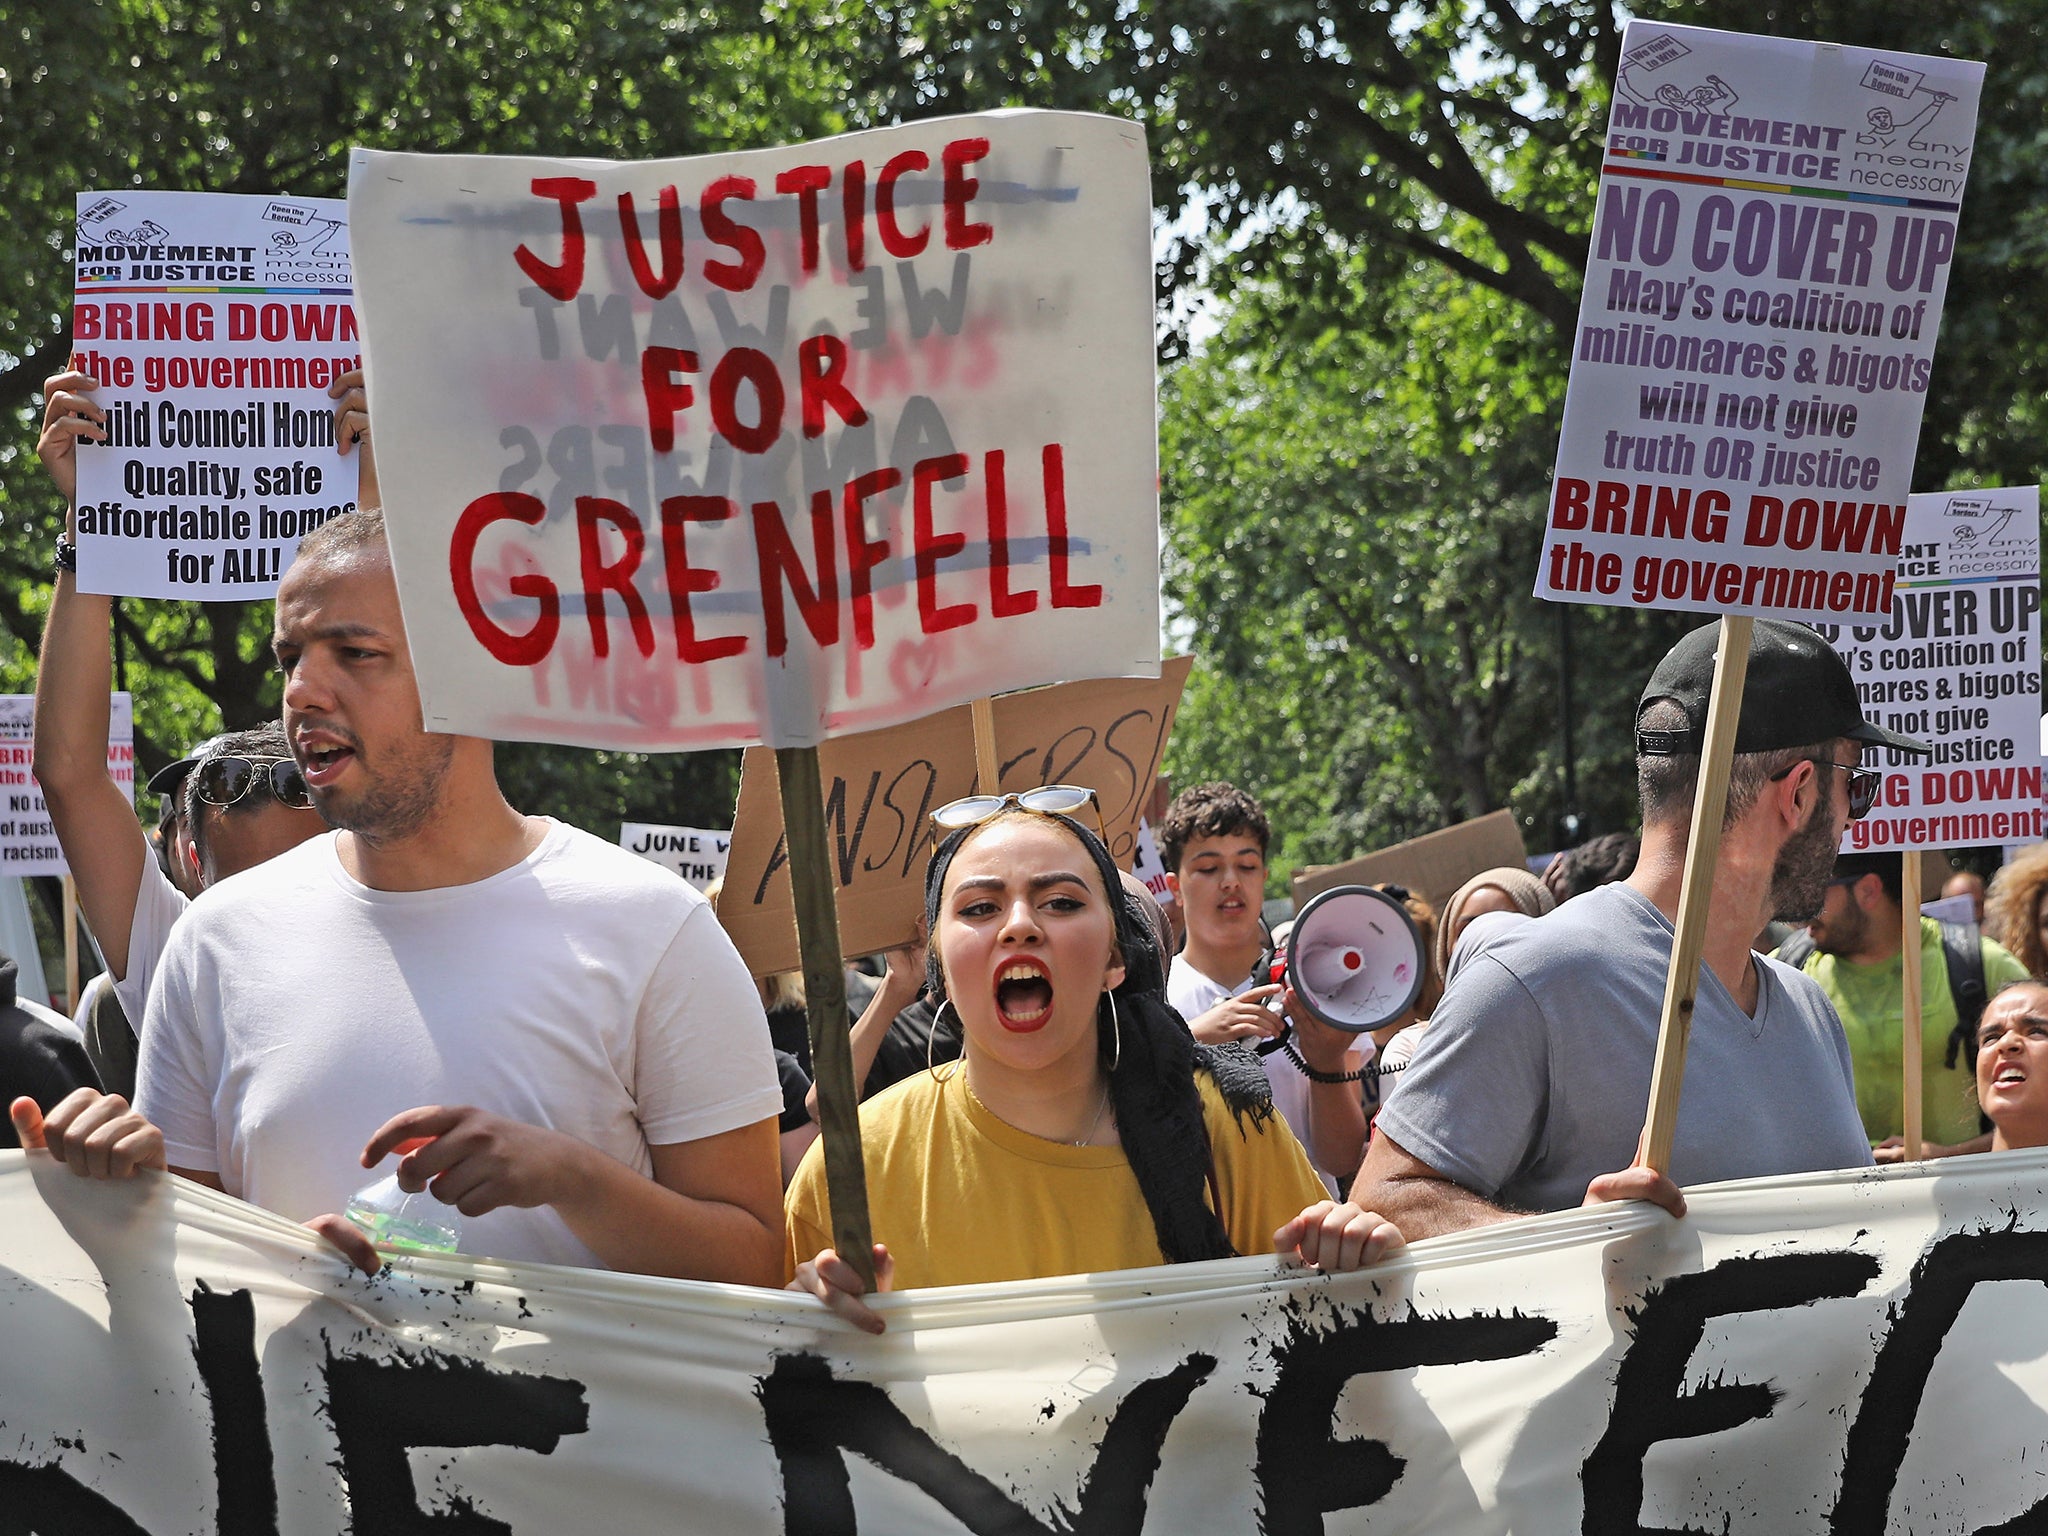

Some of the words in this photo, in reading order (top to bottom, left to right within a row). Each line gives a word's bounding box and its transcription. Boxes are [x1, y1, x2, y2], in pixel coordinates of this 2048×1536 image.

[1631, 50, 1649, 61] We
[1648, 37, 1674, 54] fight
[1645, 59, 1658, 69] to
[1656, 48, 1679, 66] WIN
[1871, 78, 1904, 97] Borders
[1873, 65, 1895, 79] Open
[1895, 72, 1909, 84] the
[1612, 104, 1846, 151] MOVEMENT
[1609, 134, 1670, 152] FOR
[1676, 140, 1841, 181] JUSTICE
[1856, 132, 1896, 149] by
[1908, 141, 1969, 158] any
[1854, 152, 1965, 173] means
[1850, 169, 1963, 198] necessary
[271, 213, 301, 225] Borders
[272, 205, 291, 215] Open
[292, 208, 305, 216] the
[514, 137, 994, 301] JUSTICE
[78, 246, 257, 262] MOVEMENT
[265, 248, 300, 258] by
[311, 251, 349, 259] an
[1597, 185, 1679, 267] NO
[1691, 194, 1878, 288] COVER
[1886, 216, 1956, 294] UP
[78, 266, 121, 277] FOR
[129, 265, 255, 281] JUSTICE
[266, 261, 352, 269] mean
[1607, 268, 1713, 321] May's
[1722, 288, 1886, 338] coalition
[1890, 300, 1926, 340] of
[74, 302, 214, 341] BRING
[228, 303, 360, 342] DOWN
[74, 351, 134, 388] the
[144, 354, 362, 392] governmen
[1579, 323, 1787, 381] milionares
[1793, 347, 1819, 383] &
[1825, 343, 1931, 393] bigots
[642, 335, 869, 454] FOR
[157, 400, 265, 448] Council
[273, 402, 335, 448] Hom
[1639, 382, 1709, 426] will
[1714, 389, 1780, 432] not
[1785, 395, 1858, 440] give
[1603, 429, 1696, 475] truth
[1703, 435, 1754, 481] OR
[1758, 442, 1881, 491] justice
[123, 460, 247, 500] Quality,
[253, 461, 322, 496] safe
[78, 502, 251, 540] affordable
[1551, 477, 1731, 544] BRING
[1743, 493, 1907, 556] DOWN
[449, 443, 1103, 666] GRENFELL
[1948, 542, 1979, 551] by
[1989, 538, 2038, 548] any
[1949, 549, 2038, 560] means
[167, 549, 215, 583] for
[221, 547, 281, 583] ALL!
[1548, 542, 1622, 595] the
[1631, 555, 1897, 614] government
[1949, 560, 2038, 574] necessary
[1991, 586, 2040, 634] UP
[1879, 641, 1994, 672] coalition
[2002, 636, 2027, 663] of
[1935, 677, 1952, 700] &
[1958, 671, 2041, 699] bigots
[1888, 709, 1930, 734] not
[1935, 706, 1989, 735] give
[1925, 736, 2014, 768] justice
[1922, 766, 2042, 806] DOWN
[10, 796, 29, 811] NO
[1, 821, 14, 836] of
[632, 833, 701, 853] JUNE
[1852, 808, 2043, 849] government
[3, 845, 58, 860] racism
[679, 863, 716, 880] THE
